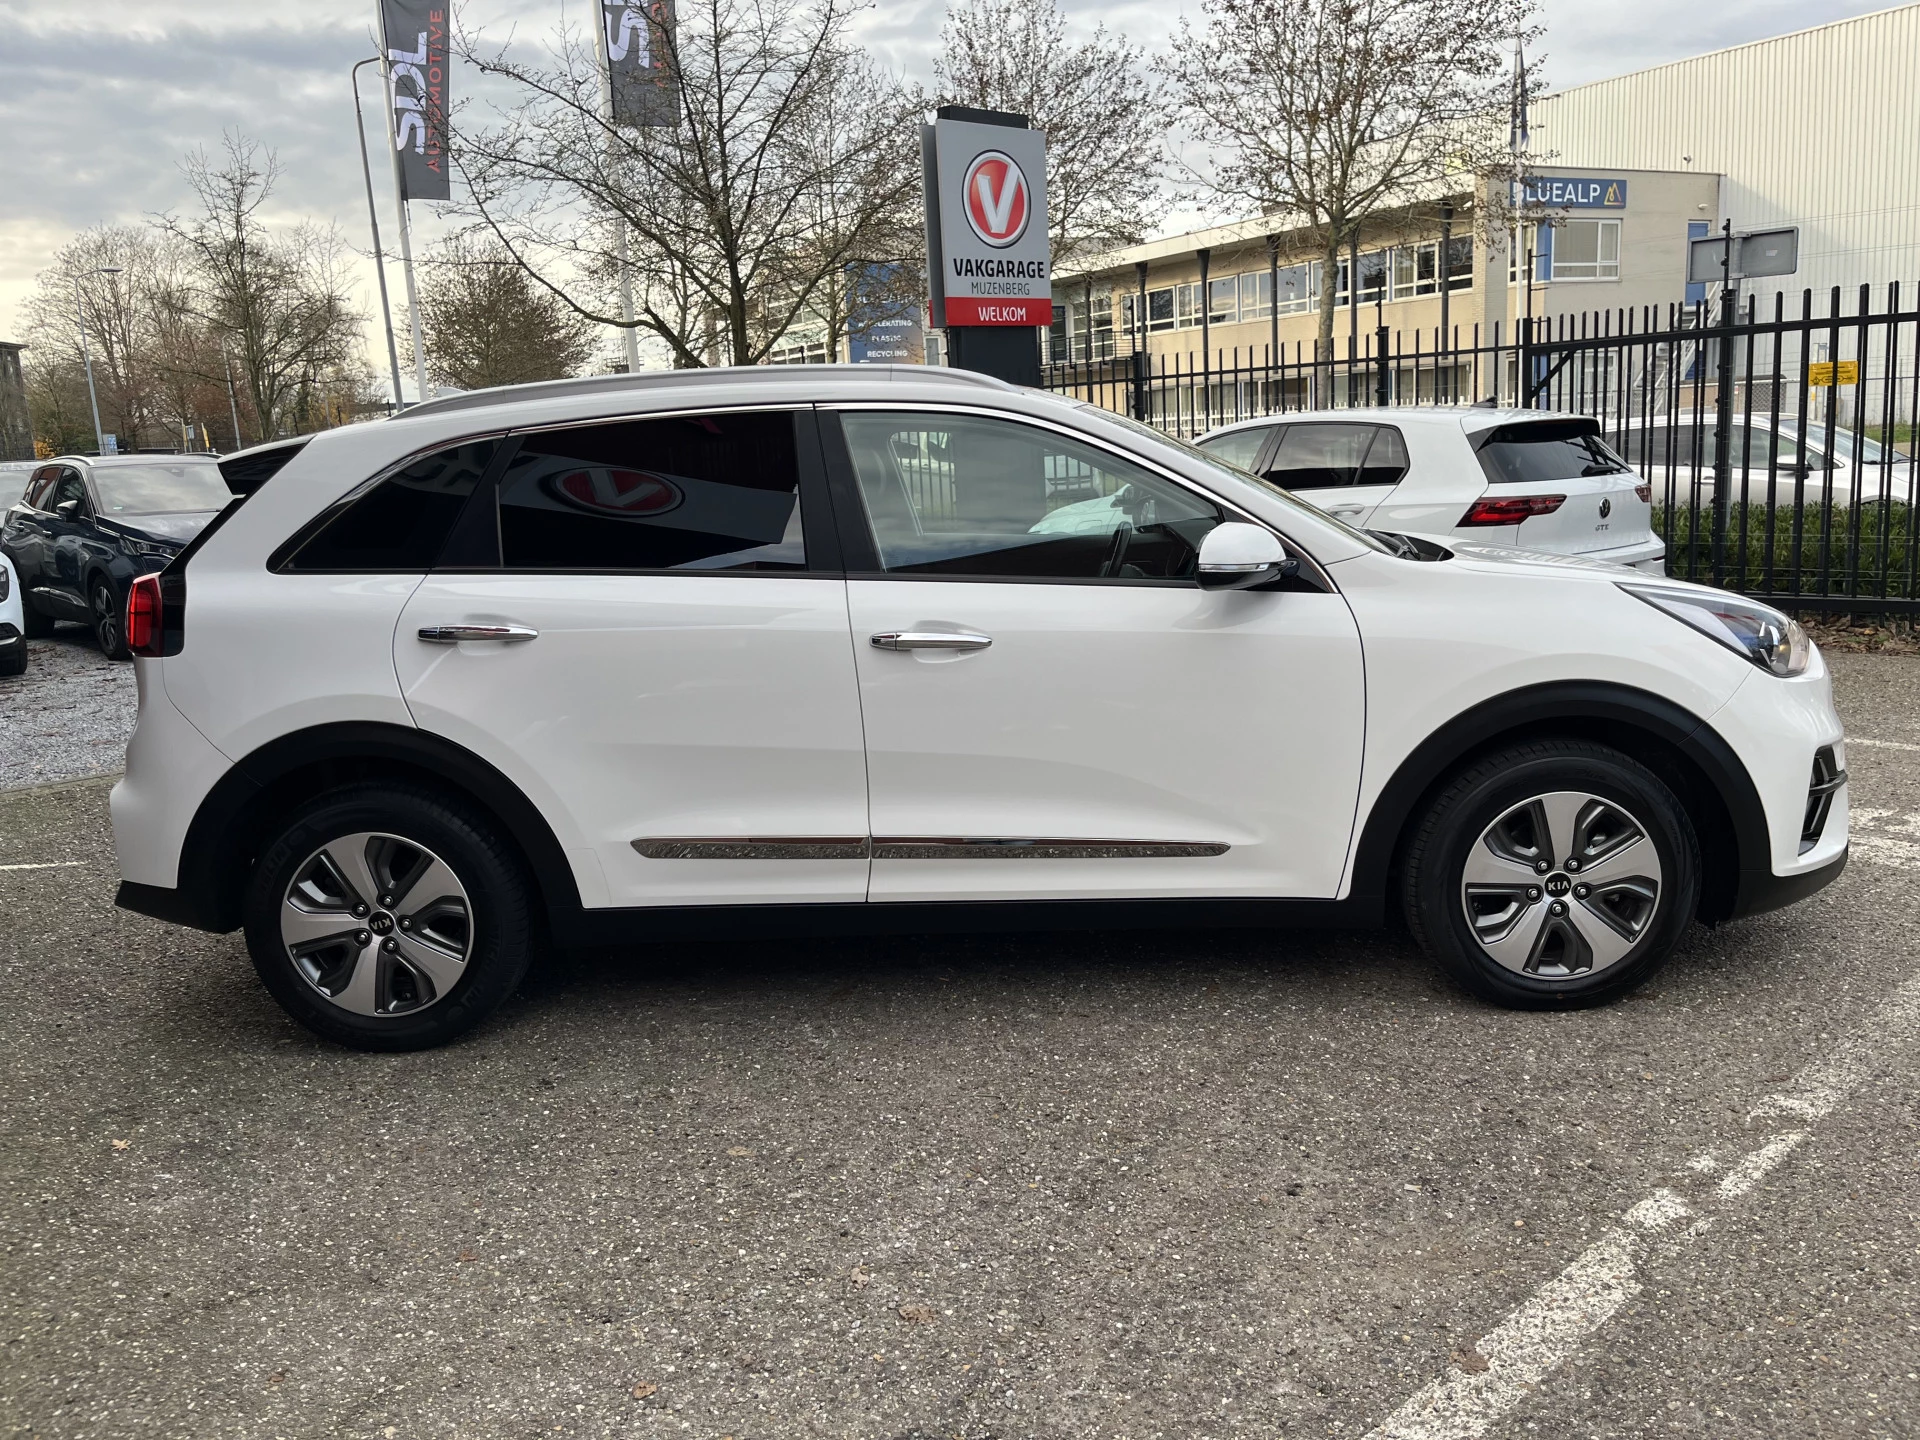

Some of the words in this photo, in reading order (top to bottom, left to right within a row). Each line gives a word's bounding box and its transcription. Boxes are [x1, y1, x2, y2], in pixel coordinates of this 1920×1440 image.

[387, 31, 428, 156] SDL
[427, 9, 444, 174] AUTOMOTIVE
[953, 258, 1045, 279] VAKGARAGE
[971, 281, 1030, 296] MUZENBERG
[977, 306, 1027, 323] WELKOM
[858, 319, 913, 328] ALERATING
[867, 350, 908, 358] RECYCLING
[1547, 880, 1570, 891] KIA
[370, 918, 392, 930] KIA
